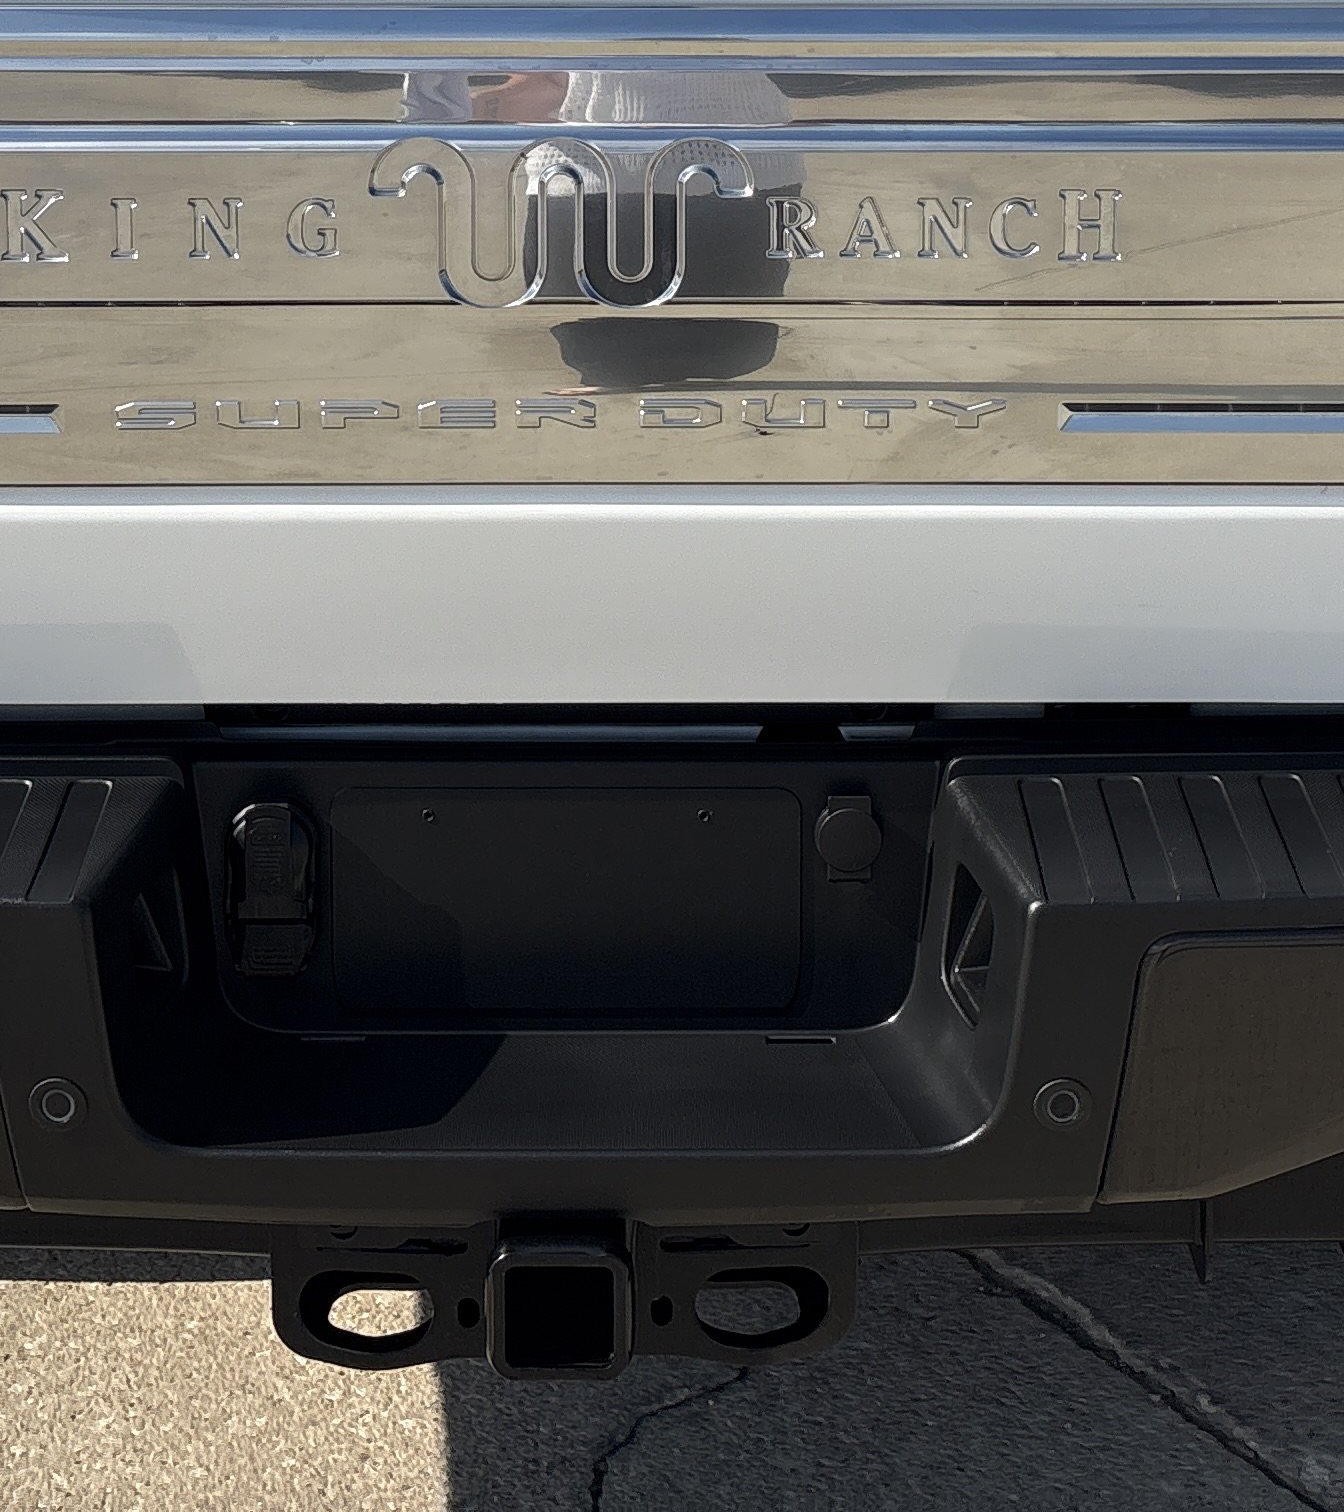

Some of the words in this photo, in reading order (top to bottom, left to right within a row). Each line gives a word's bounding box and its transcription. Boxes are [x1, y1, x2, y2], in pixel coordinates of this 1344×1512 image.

[0, 188, 340, 263] KING
[764, 188, 1123, 262] RANCH
[115, 399, 597, 430] SUPER
[639, 398, 1007, 429] DUTY
